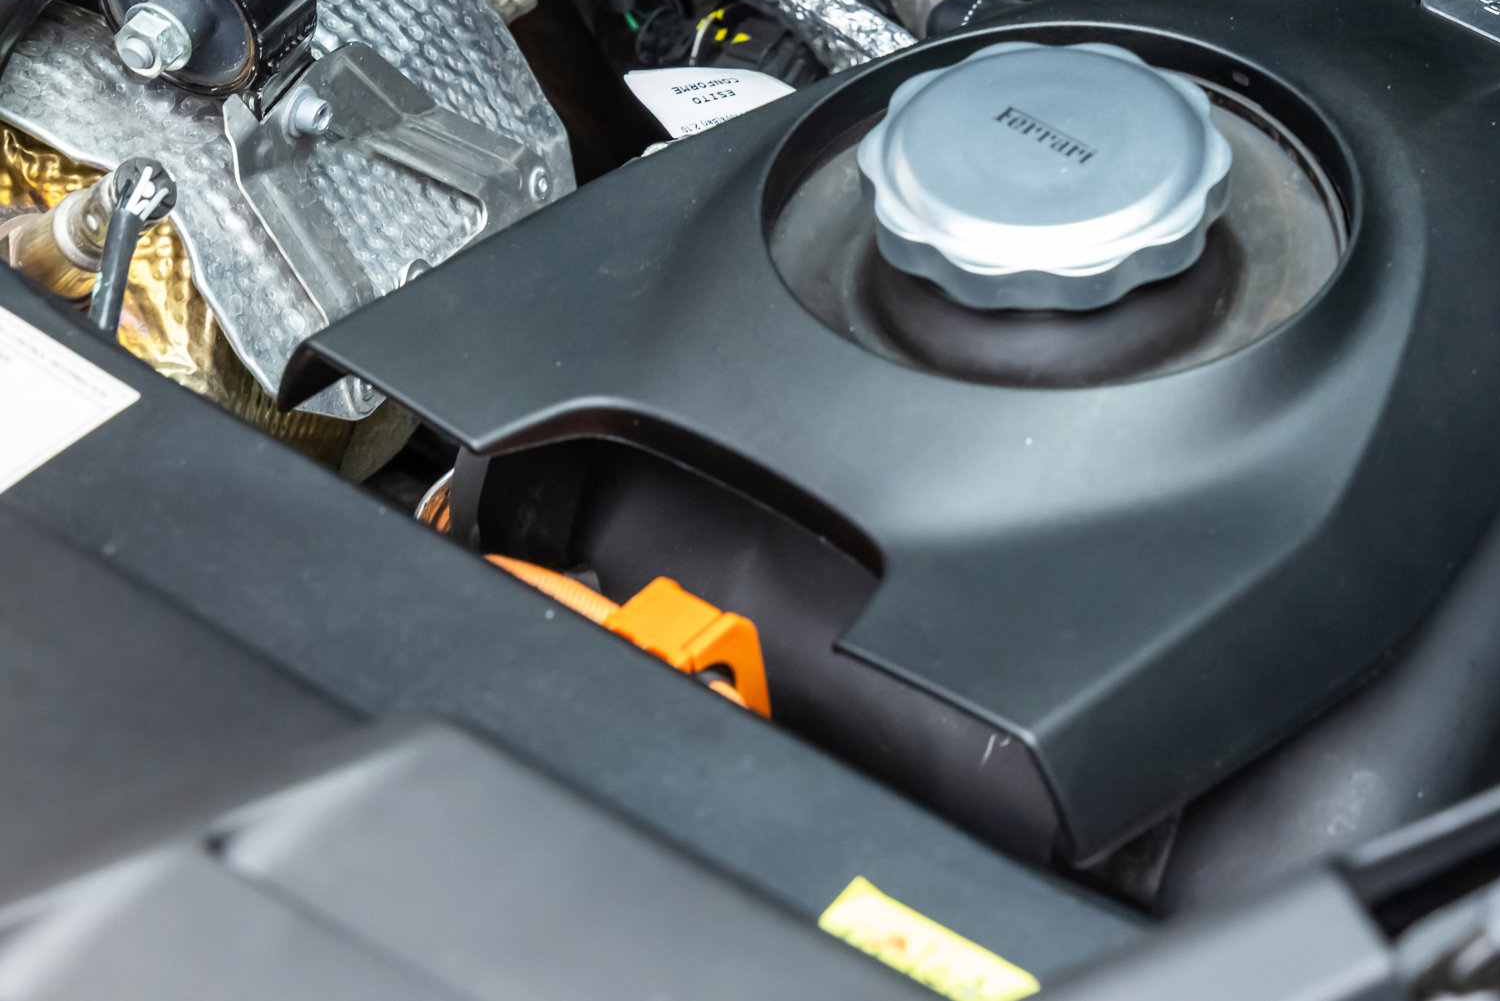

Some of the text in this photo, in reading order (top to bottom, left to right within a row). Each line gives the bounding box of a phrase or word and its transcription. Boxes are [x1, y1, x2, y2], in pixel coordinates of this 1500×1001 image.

[671, 77, 739, 95] CONFORME
[692, 89, 736, 105] ESITO
[994, 105, 1098, 165] Ferrari
